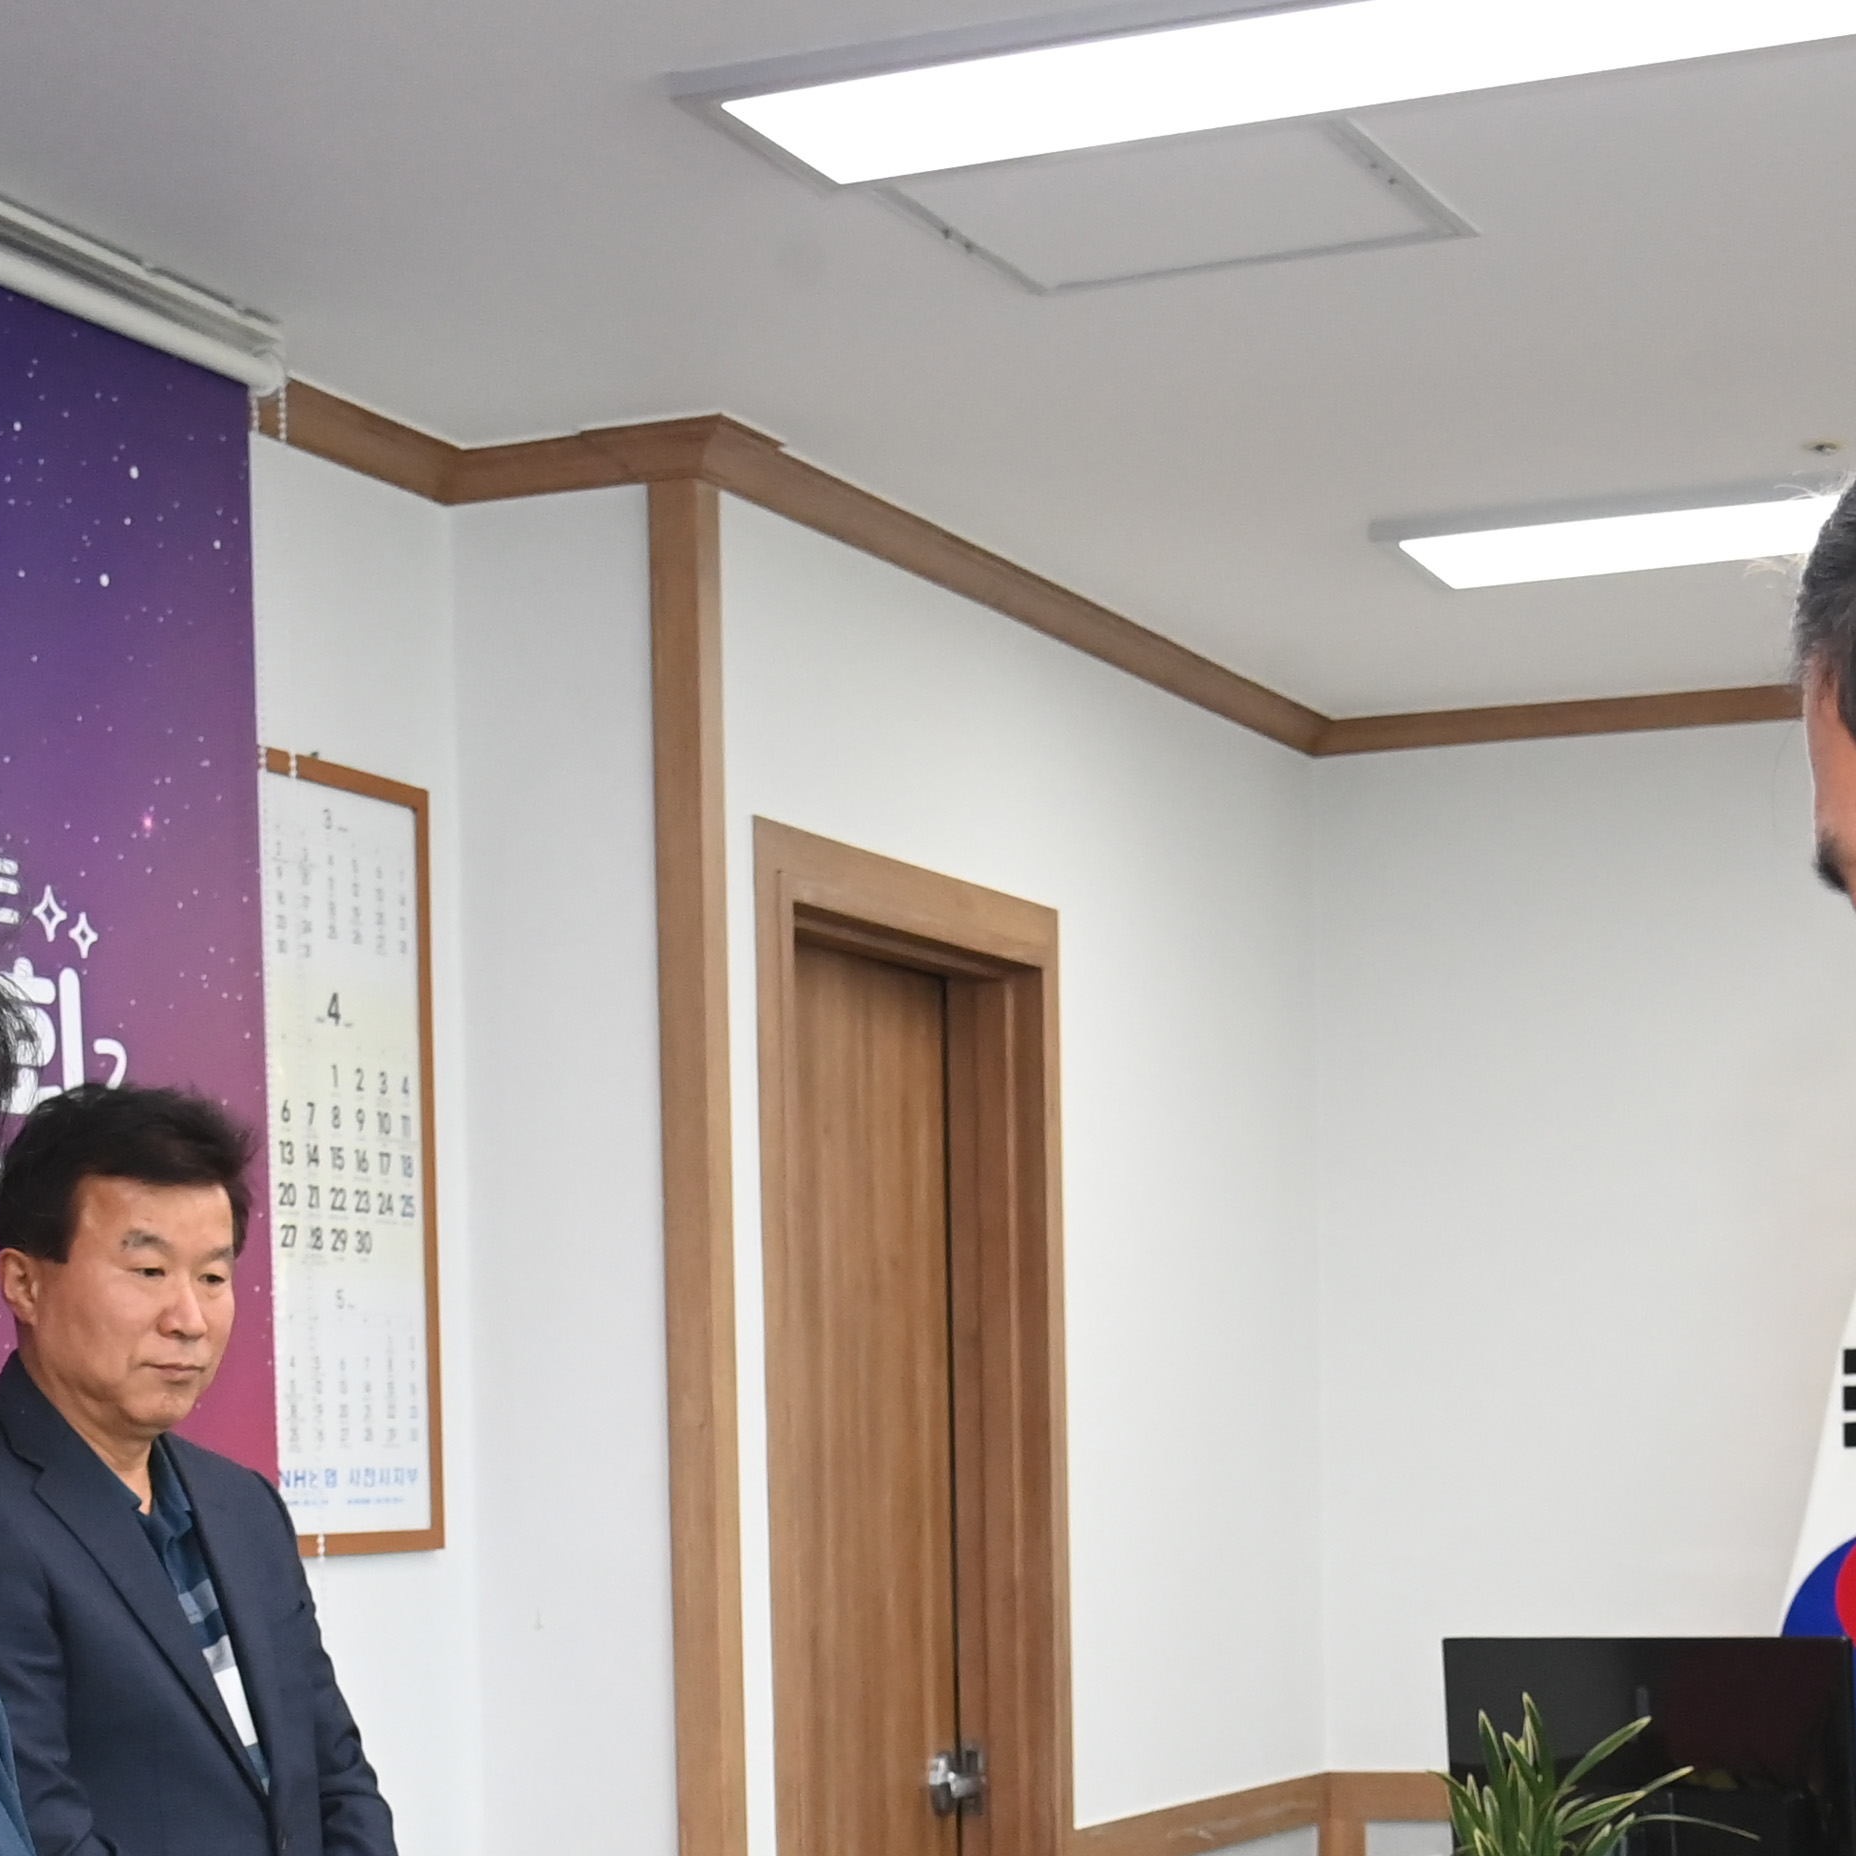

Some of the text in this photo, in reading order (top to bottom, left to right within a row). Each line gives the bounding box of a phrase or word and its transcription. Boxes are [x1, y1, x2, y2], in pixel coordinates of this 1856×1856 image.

[327, 992, 341, 1027] 4
[331, 1063, 339, 1089] 1
[354, 1067, 365, 1092] 2
[378, 1071, 388, 1095] 3
[280, 1099, 291, 1123] 6
[306, 1101, 315, 1126] 7
[331, 1105, 341, 1130] 8
[355, 1107, 365, 1132] 9
[376, 1110, 392, 1135] 10
[278, 1140, 295, 1165] 13
[305, 1143, 320, 1168] 14
[329, 1146, 345, 1171] 15
[354, 1148, 370, 1173] 16
[378, 1151, 392, 1176] 17
[278, 1182, 415, 1218] 20 21 22 23 24 25
[280, 1224, 297, 1248] 27
[330, 1228, 348, 1252] 29
[354, 1230, 372, 1254] 30
